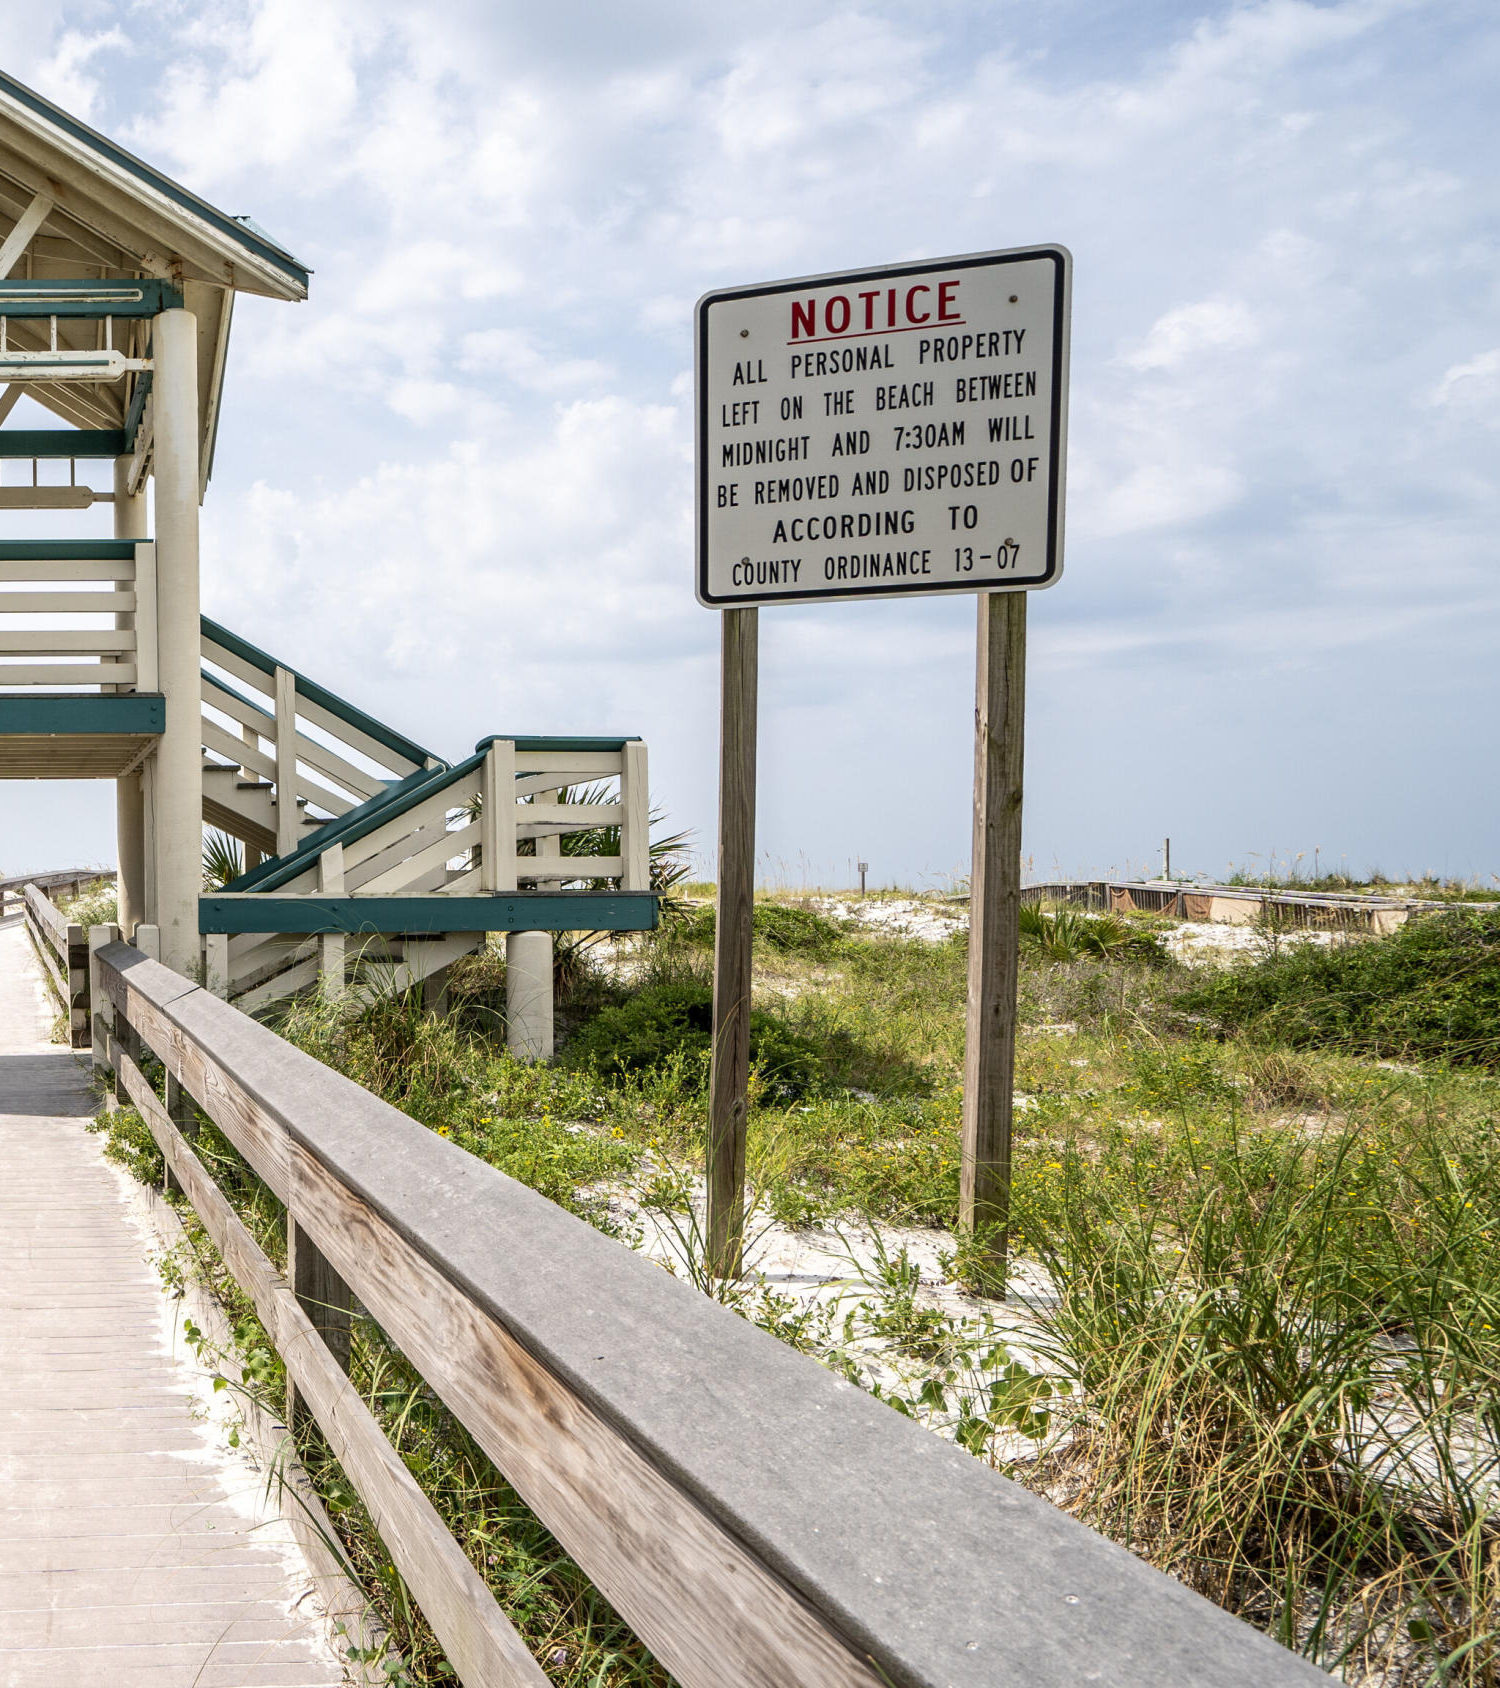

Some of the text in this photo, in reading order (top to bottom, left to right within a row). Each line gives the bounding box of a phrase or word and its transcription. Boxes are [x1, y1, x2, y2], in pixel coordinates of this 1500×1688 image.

[790, 280, 962, 339] NOTICE
[732, 328, 1027, 387] ALL PERSONAL PROPERTY
[722, 370, 1037, 428] LEFT ON THE BEACH BETWEEN
[722, 414, 1035, 468] MIDNIGHT AND 7:30AM WILL
[717, 456, 1040, 509] BE REMOVED AND DISPOSED OF
[772, 504, 978, 544] ACCORDING TO
[732, 557, 802, 587] COUNTY
[824, 549, 932, 581] ORDINANCE
